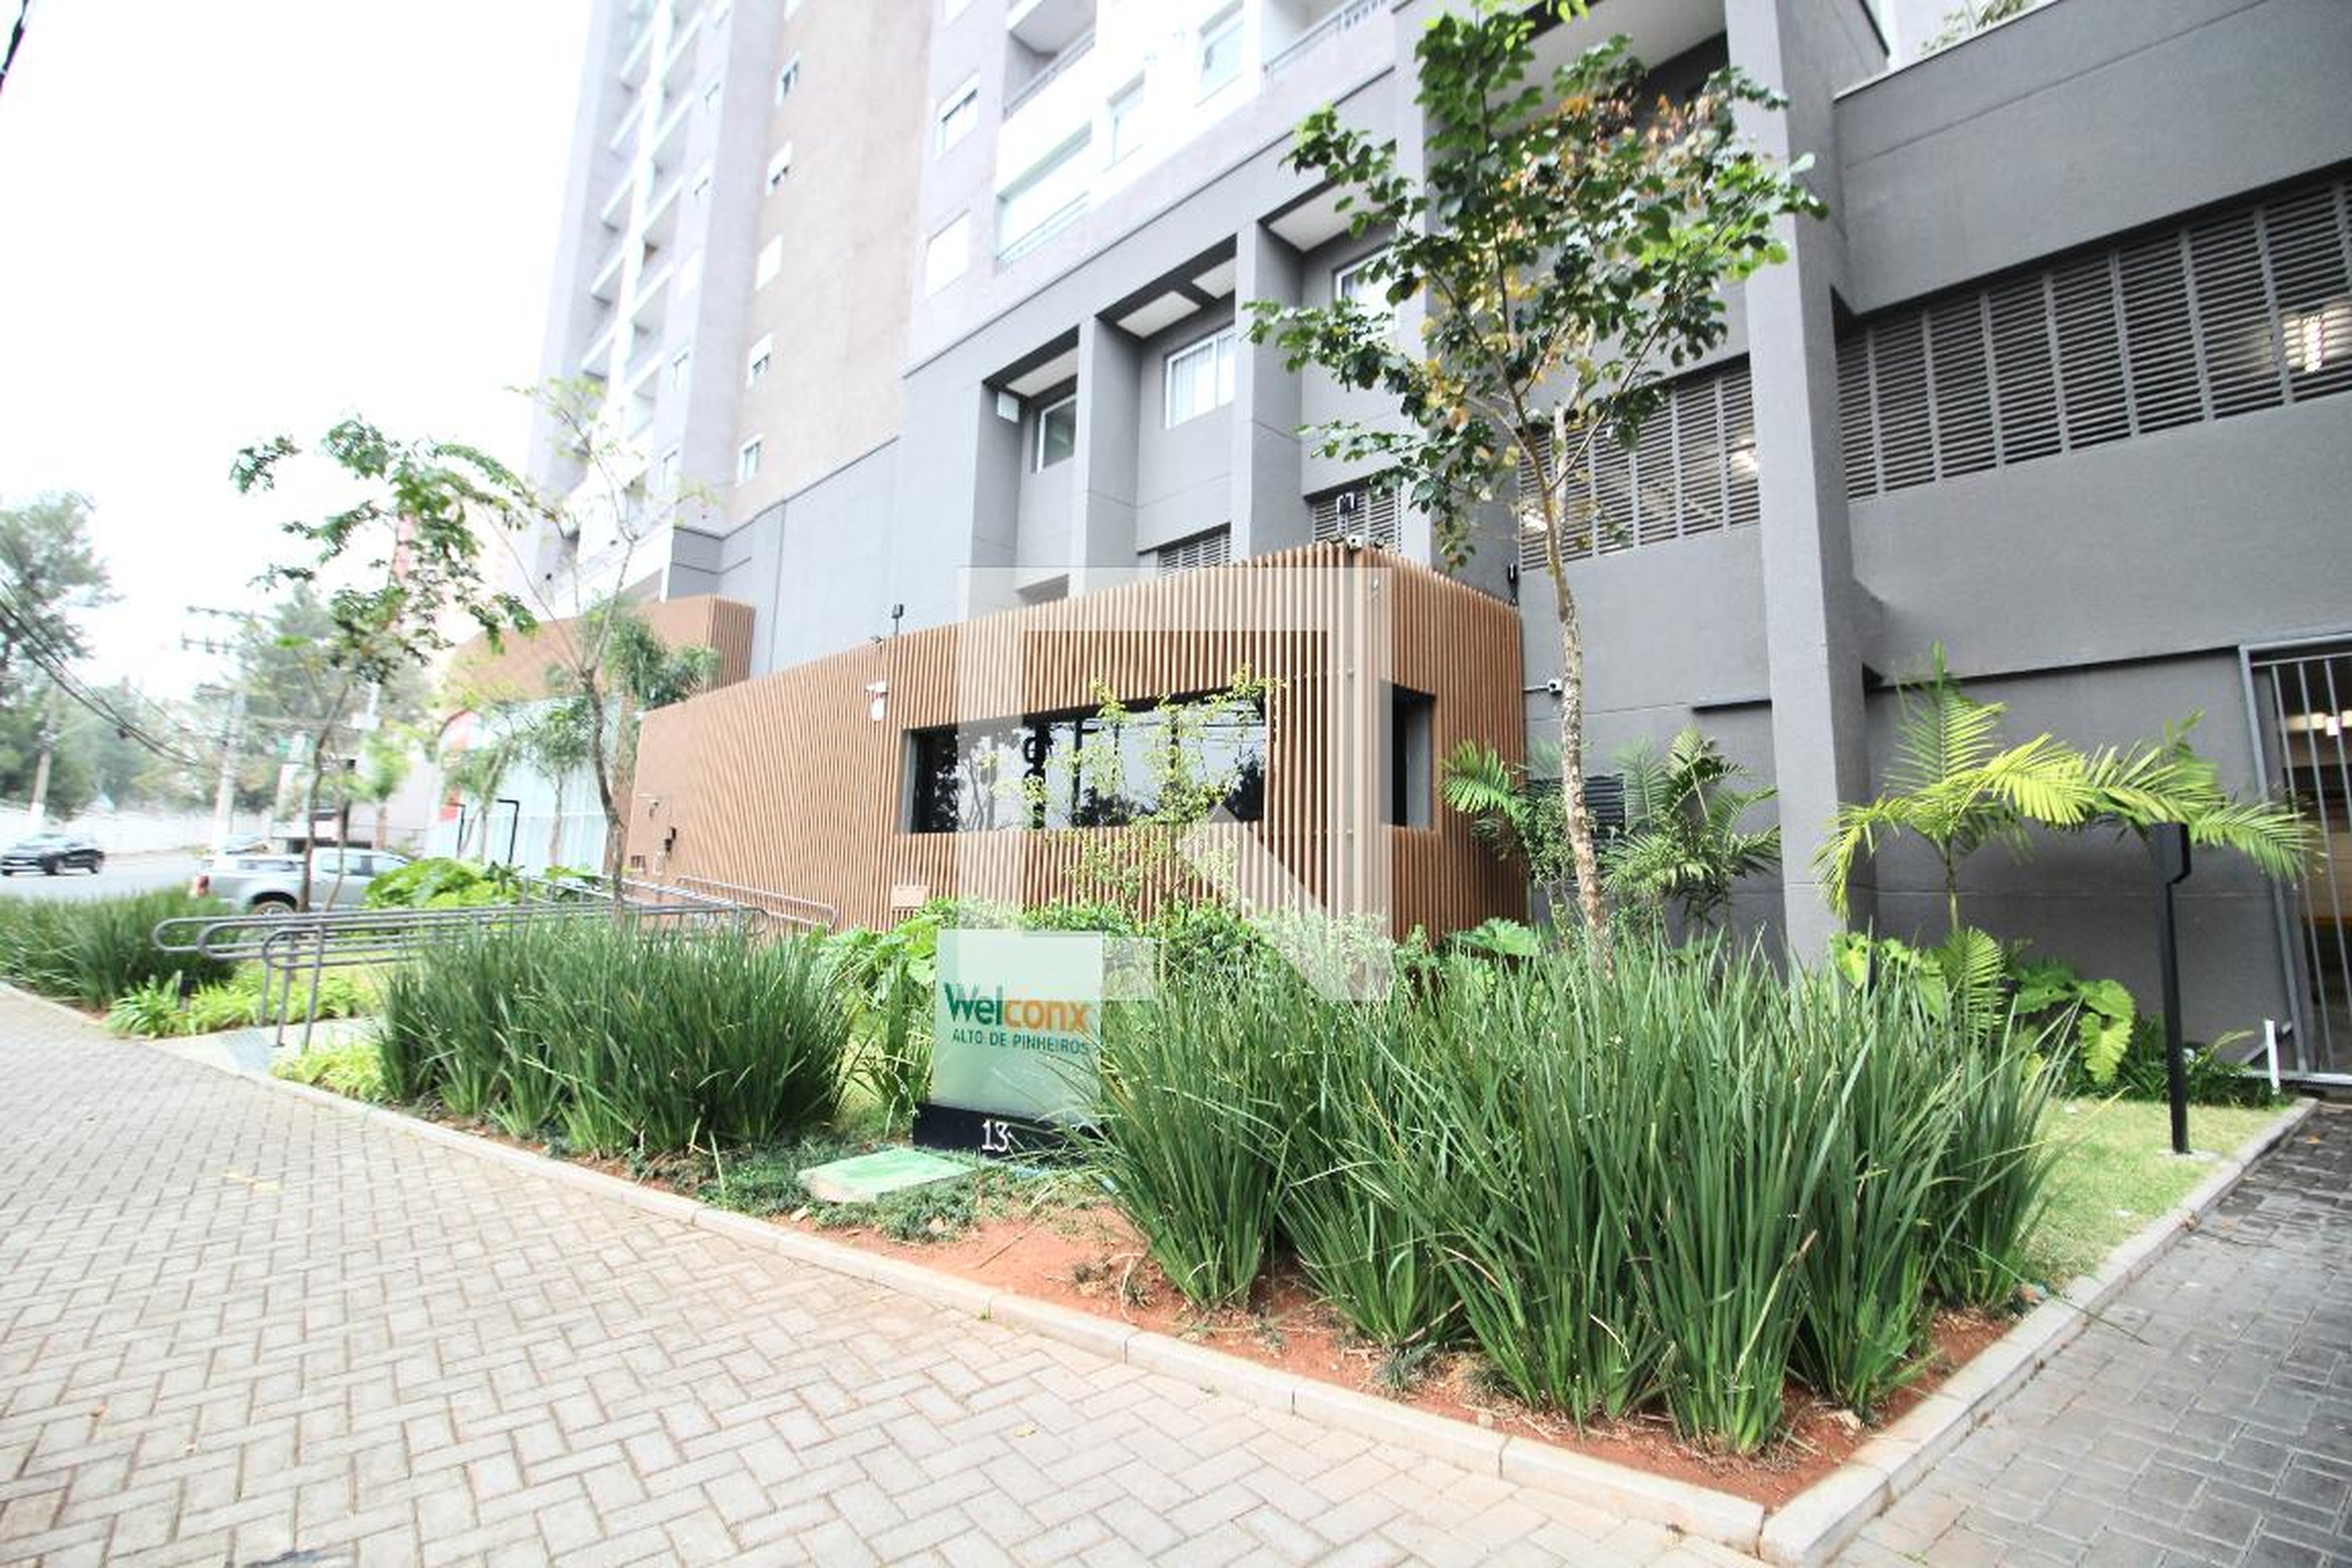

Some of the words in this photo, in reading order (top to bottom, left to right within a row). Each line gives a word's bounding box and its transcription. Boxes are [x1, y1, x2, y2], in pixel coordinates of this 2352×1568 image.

[952, 1028, 983, 1044] ALTO
[989, 1031, 1007, 1046] DE
[1012, 1034, 1089, 1055] PINHEIROS
